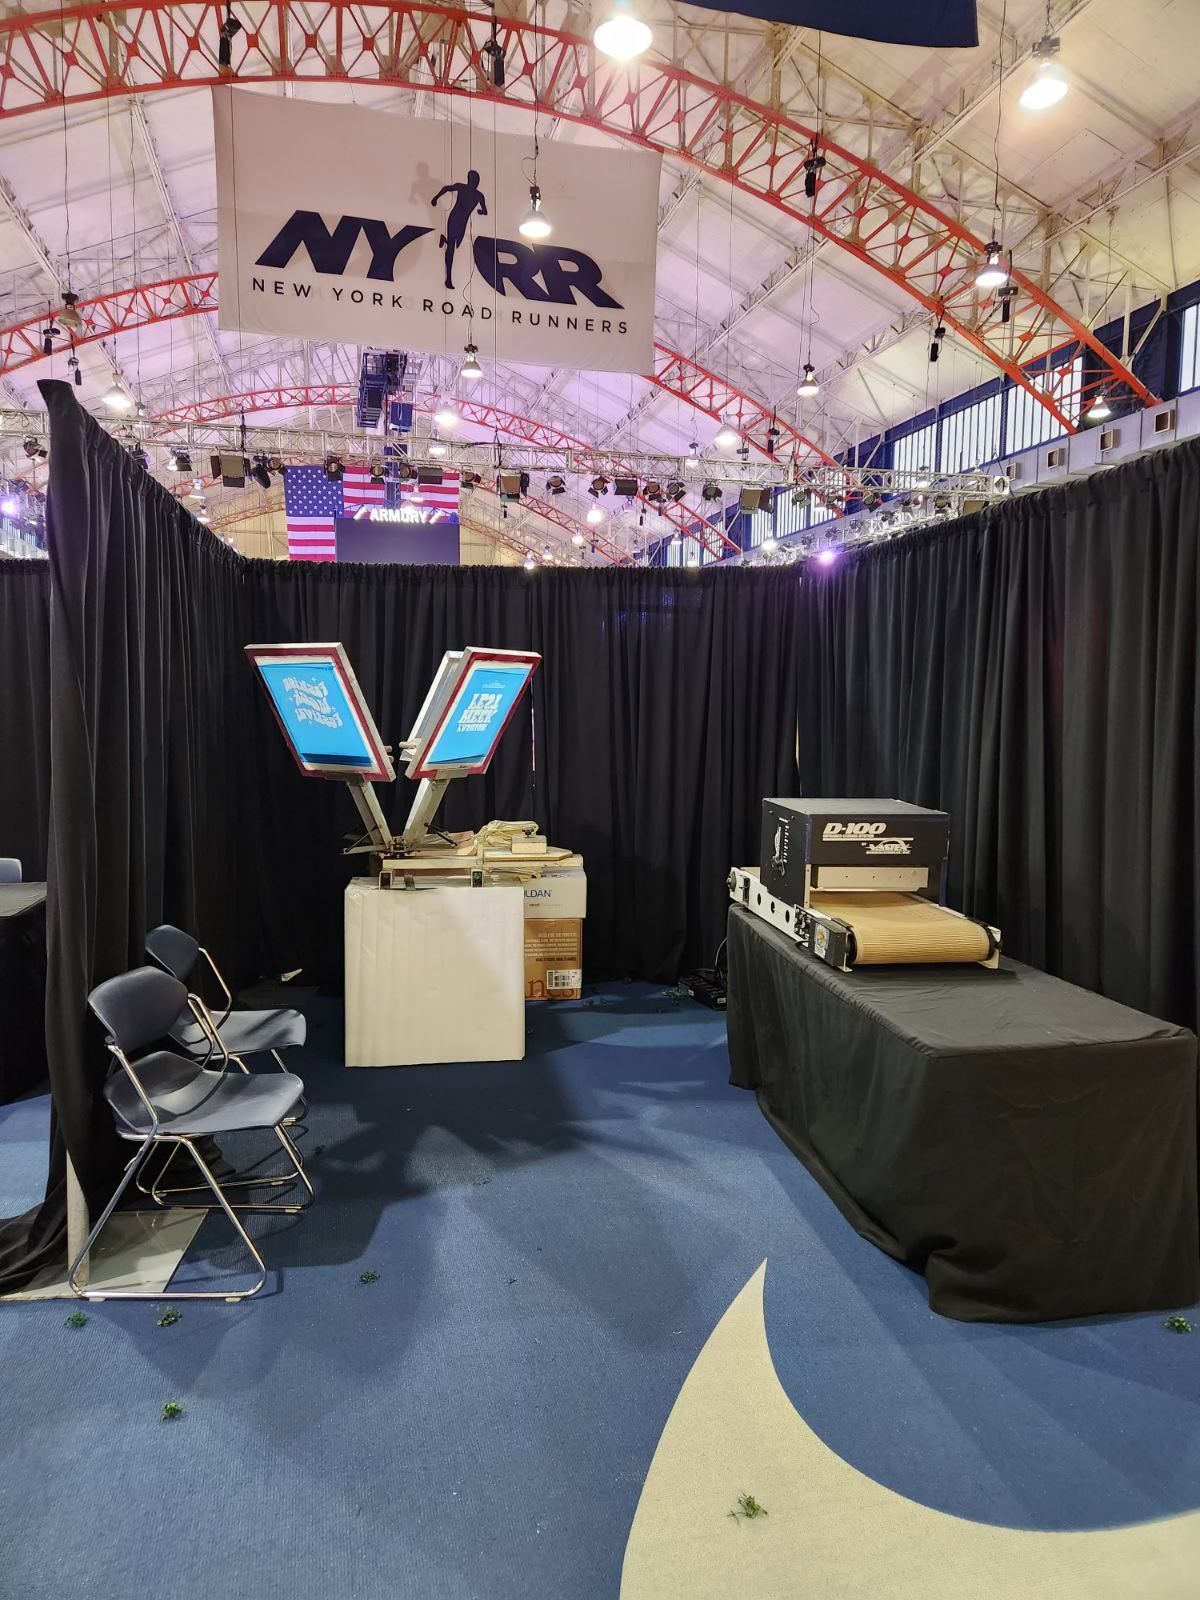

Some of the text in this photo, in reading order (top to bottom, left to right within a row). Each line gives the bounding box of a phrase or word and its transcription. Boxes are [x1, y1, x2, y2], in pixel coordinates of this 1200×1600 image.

[253, 278, 628, 334] NEW YORK ROAD RUNNERS
[369, 507, 428, 524] ARMORY
[823, 823, 887, 834] D-100
